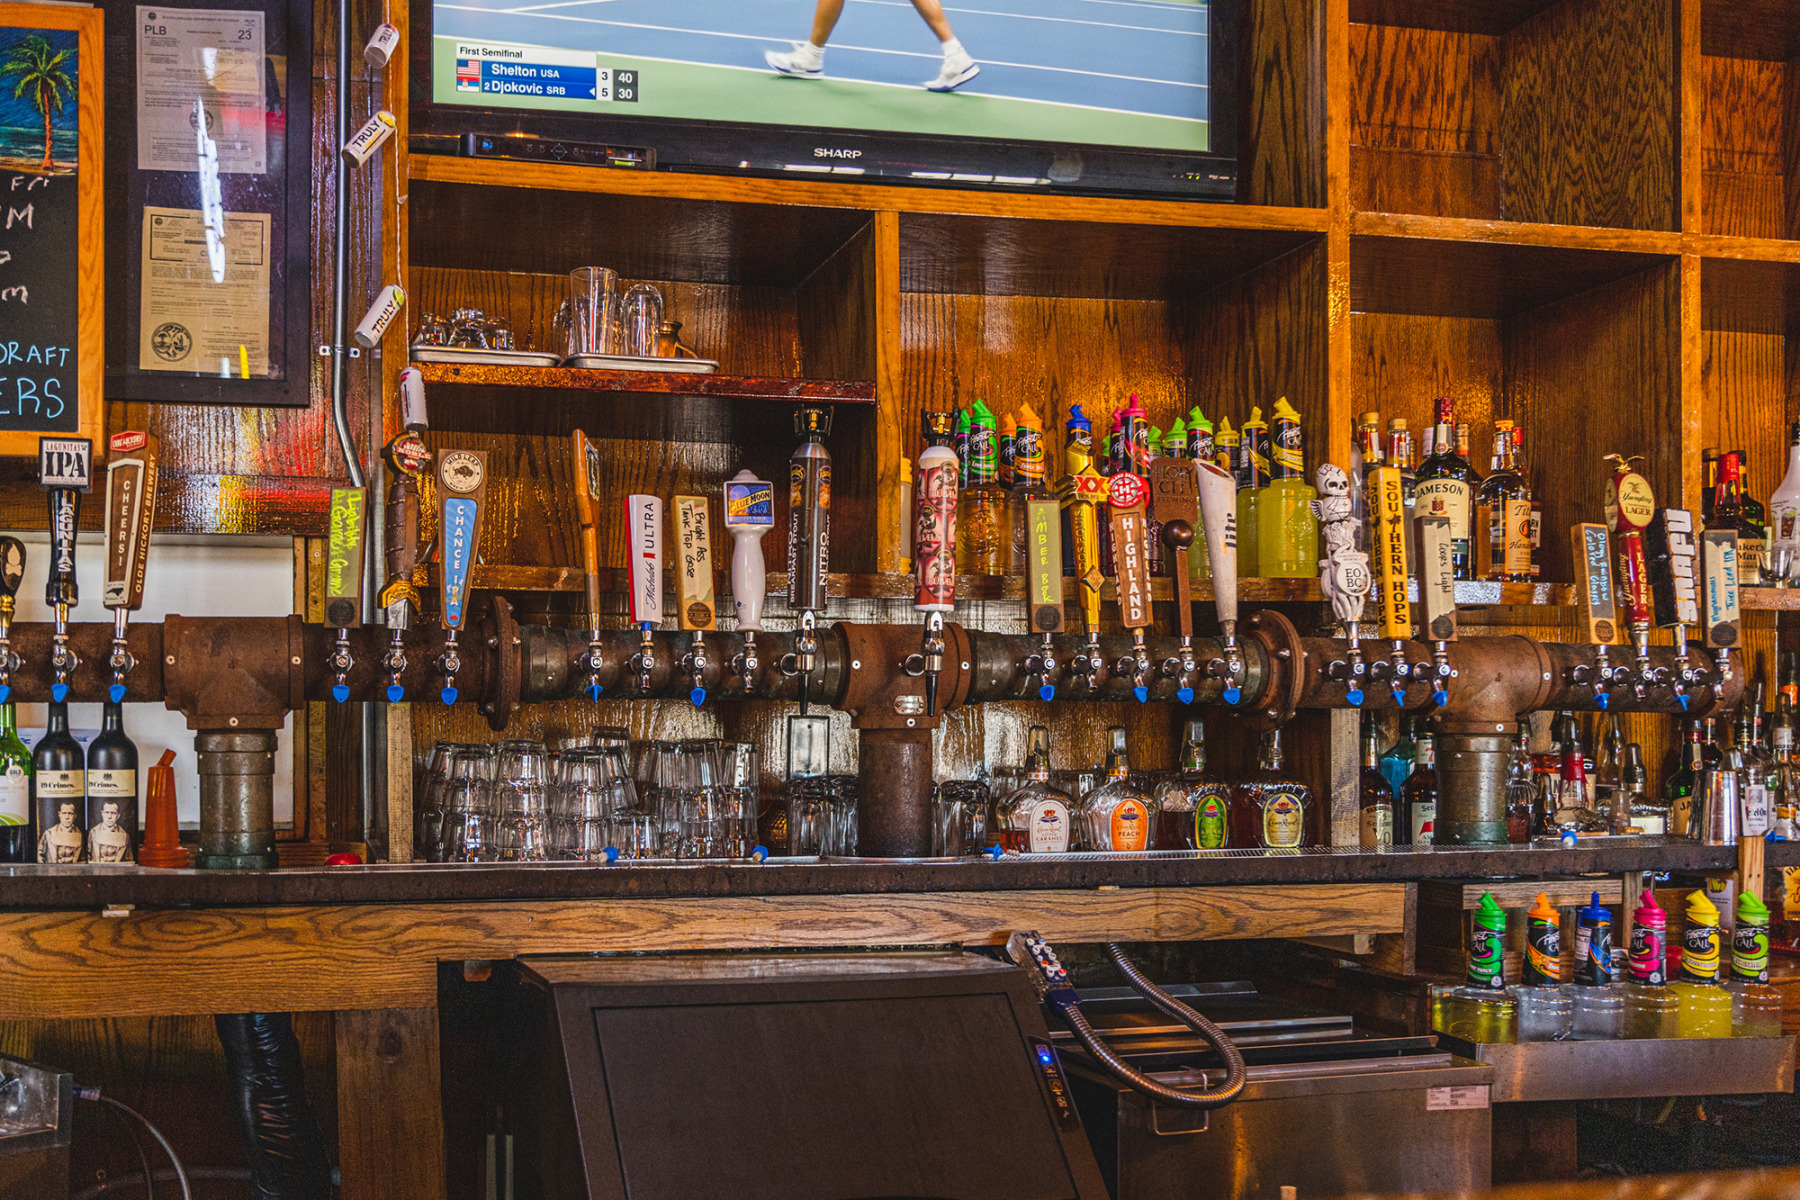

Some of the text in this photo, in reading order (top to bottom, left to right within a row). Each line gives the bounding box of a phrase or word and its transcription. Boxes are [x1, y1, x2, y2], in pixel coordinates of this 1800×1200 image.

[144, 24, 167, 36] PLB
[238, 29, 252, 40] 23
[459, 46, 523, 59] First Semifinal
[491, 63, 560, 79] Shelton USA
[601, 71, 608, 81] 3
[617, 72, 633, 84] 40
[484, 80, 566, 96] 2 Djokovic SRB
[601, 87, 609, 97] 5
[617, 88, 633, 100] 30
[351, 119, 380, 148] TRULY
[813, 147, 862, 159] SHARP
[371, 300, 396, 334] TRULY
[46, 442, 81, 452] LAGUNITAS
[44, 451, 87, 478] IPA
[750, 491, 770, 504] MOON
[1416, 483, 1464, 500] JAMESON
[1619, 491, 1653, 505] Yuengling
[1624, 505, 1652, 517] LAGER
[134, 453, 157, 594] OLDE HICKORY BREWERY
[693, 511, 706, 543] Bright
[57, 497, 74, 573] LAGUNITAS
[1035, 507, 1049, 566] AMBER
[450, 505, 465, 607] CHANCE IPA
[643, 501, 656, 611] Michelob ULTRA
[818, 531, 828, 587] NITRO
[790, 547, 798, 603] BREAKFAST
[1122, 517, 1142, 620] HIGHLAND
[1344, 567, 1362, 578] EO
[1346, 577, 1362, 588] BC
[1618, 552, 1637, 607] Yuengling
[1636, 551, 1649, 605] LAGER
[1377, 583, 1387, 628] HOPS
[1392, 582, 1407, 625] HOPS
[40, 781, 50, 789] 19
